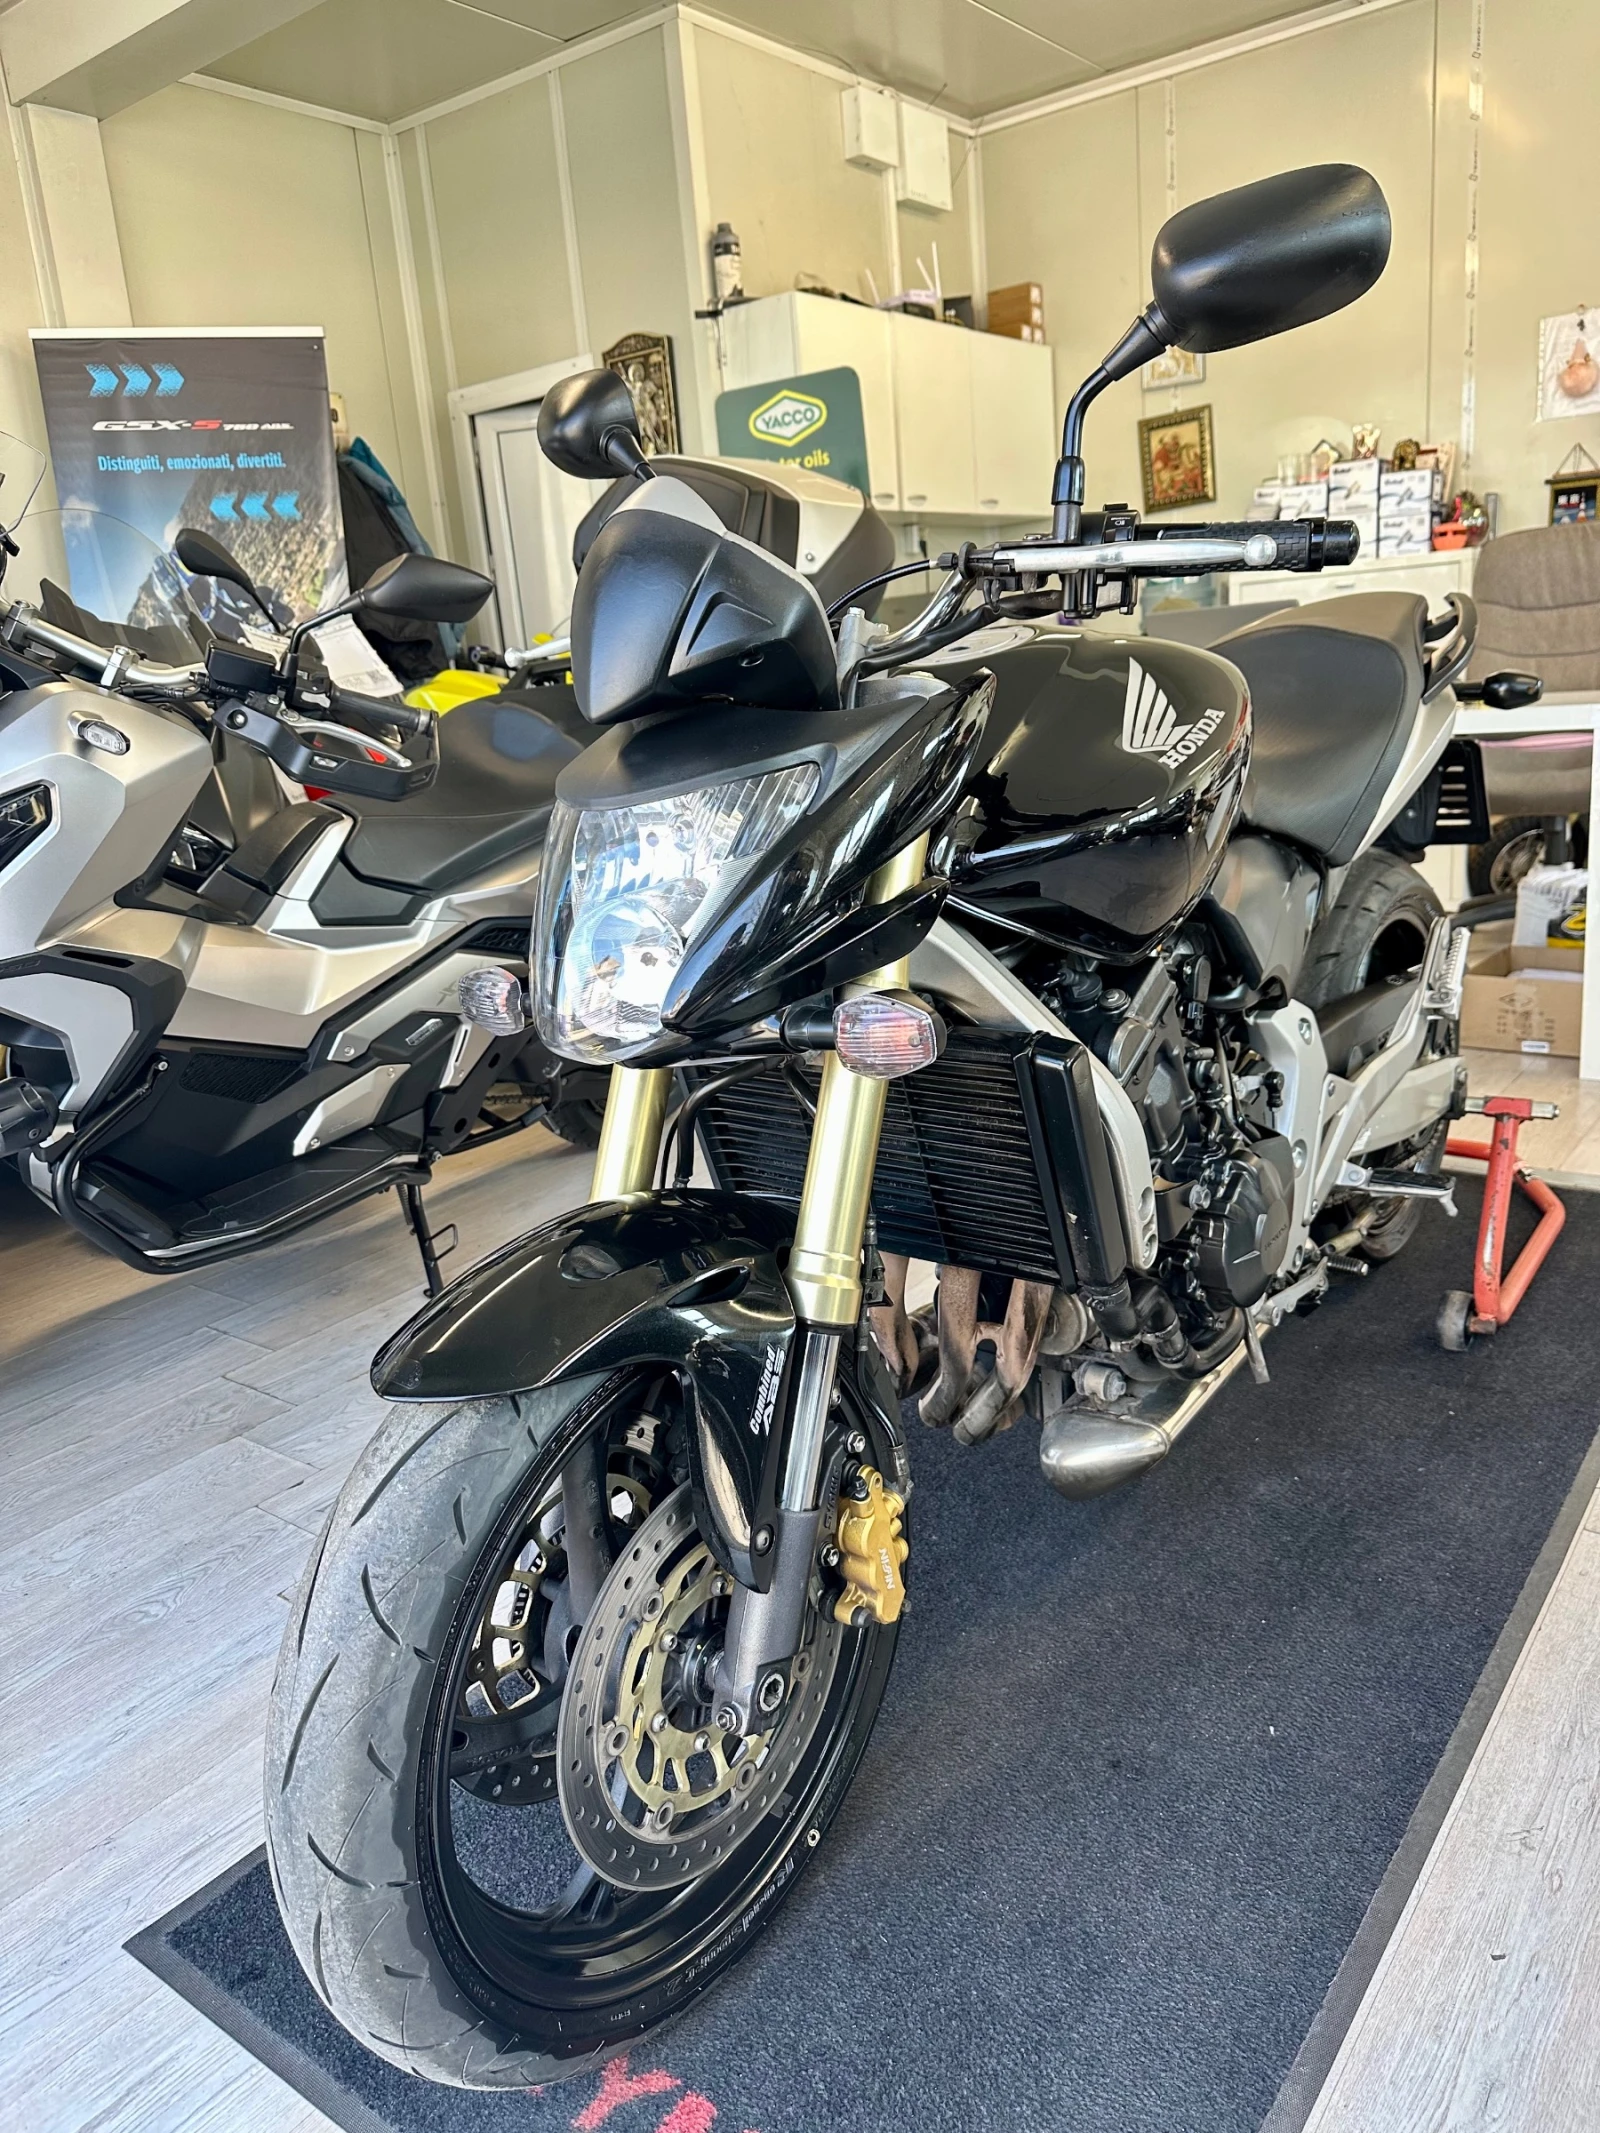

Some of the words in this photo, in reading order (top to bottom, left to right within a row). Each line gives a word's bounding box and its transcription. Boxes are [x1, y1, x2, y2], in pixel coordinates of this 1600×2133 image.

[92, 419, 222, 431] GSX-S
[762, 407, 815, 430] YACCO
[97, 455, 164, 474] Distinguiti,
[166, 453, 235, 472] emozionati,
[237, 451, 287, 470] divertiti.
[803, 448, 830, 469] oils
[1158, 708, 1226, 770] HONDA
[750, 1343, 776, 1434] Combined
[763, 1346, 786, 1436] ABS
[878, 1547, 896, 1590] NISSIN
